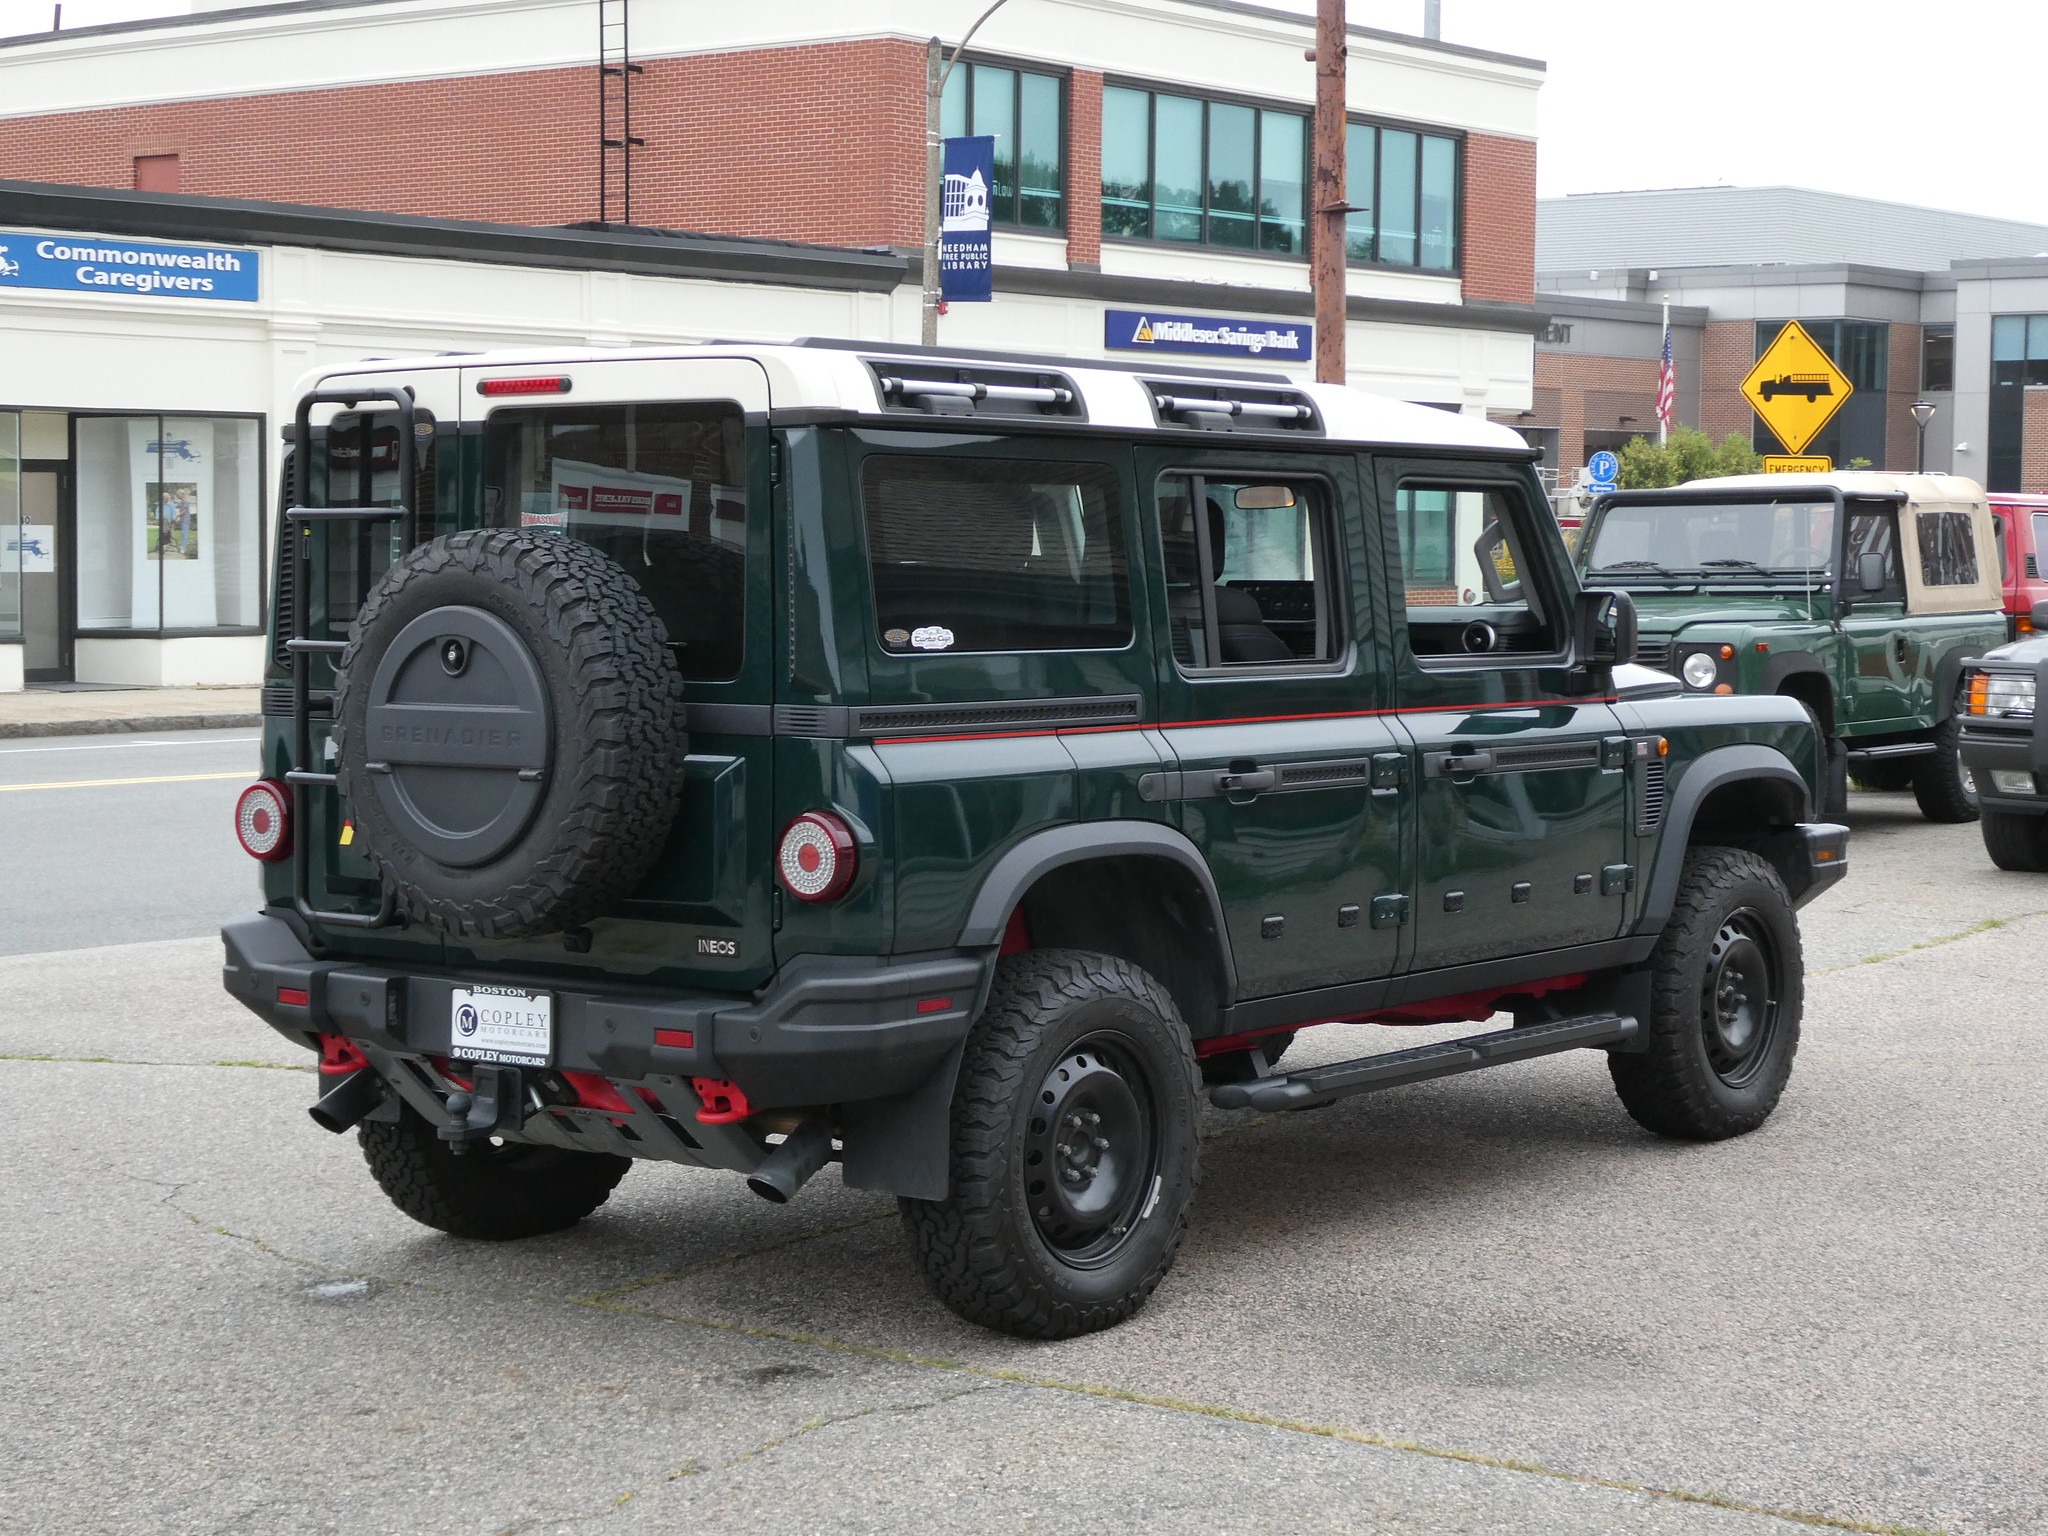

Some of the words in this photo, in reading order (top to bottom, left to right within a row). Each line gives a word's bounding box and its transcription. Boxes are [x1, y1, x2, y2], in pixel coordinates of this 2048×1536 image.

[943, 243, 988, 252] NEEDHAM
[36, 241, 241, 272] Commonwealth
[961, 252, 988, 260] PUBLIC
[943, 261, 988, 270] LIBRARY
[76, 266, 214, 292] Caregivers
[1153, 321, 1219, 342] Middlesex
[1218, 326, 1267, 353] Savings
[1266, 330, 1299, 349] Bank
[1599, 460, 1610, 475] P
[1769, 464, 1825, 473] EMERGENCY
[380, 725, 521, 748] GRENADIER
[698, 939, 736, 955] INEOS
[473, 986, 527, 997] BOSTON
[481, 1009, 547, 1027] COPLEY
[481, 1026, 547, 1038] MOTORCARS
[461, 1048, 499, 1062] COPLEY
[499, 1054, 546, 1066] MOTORCARS
